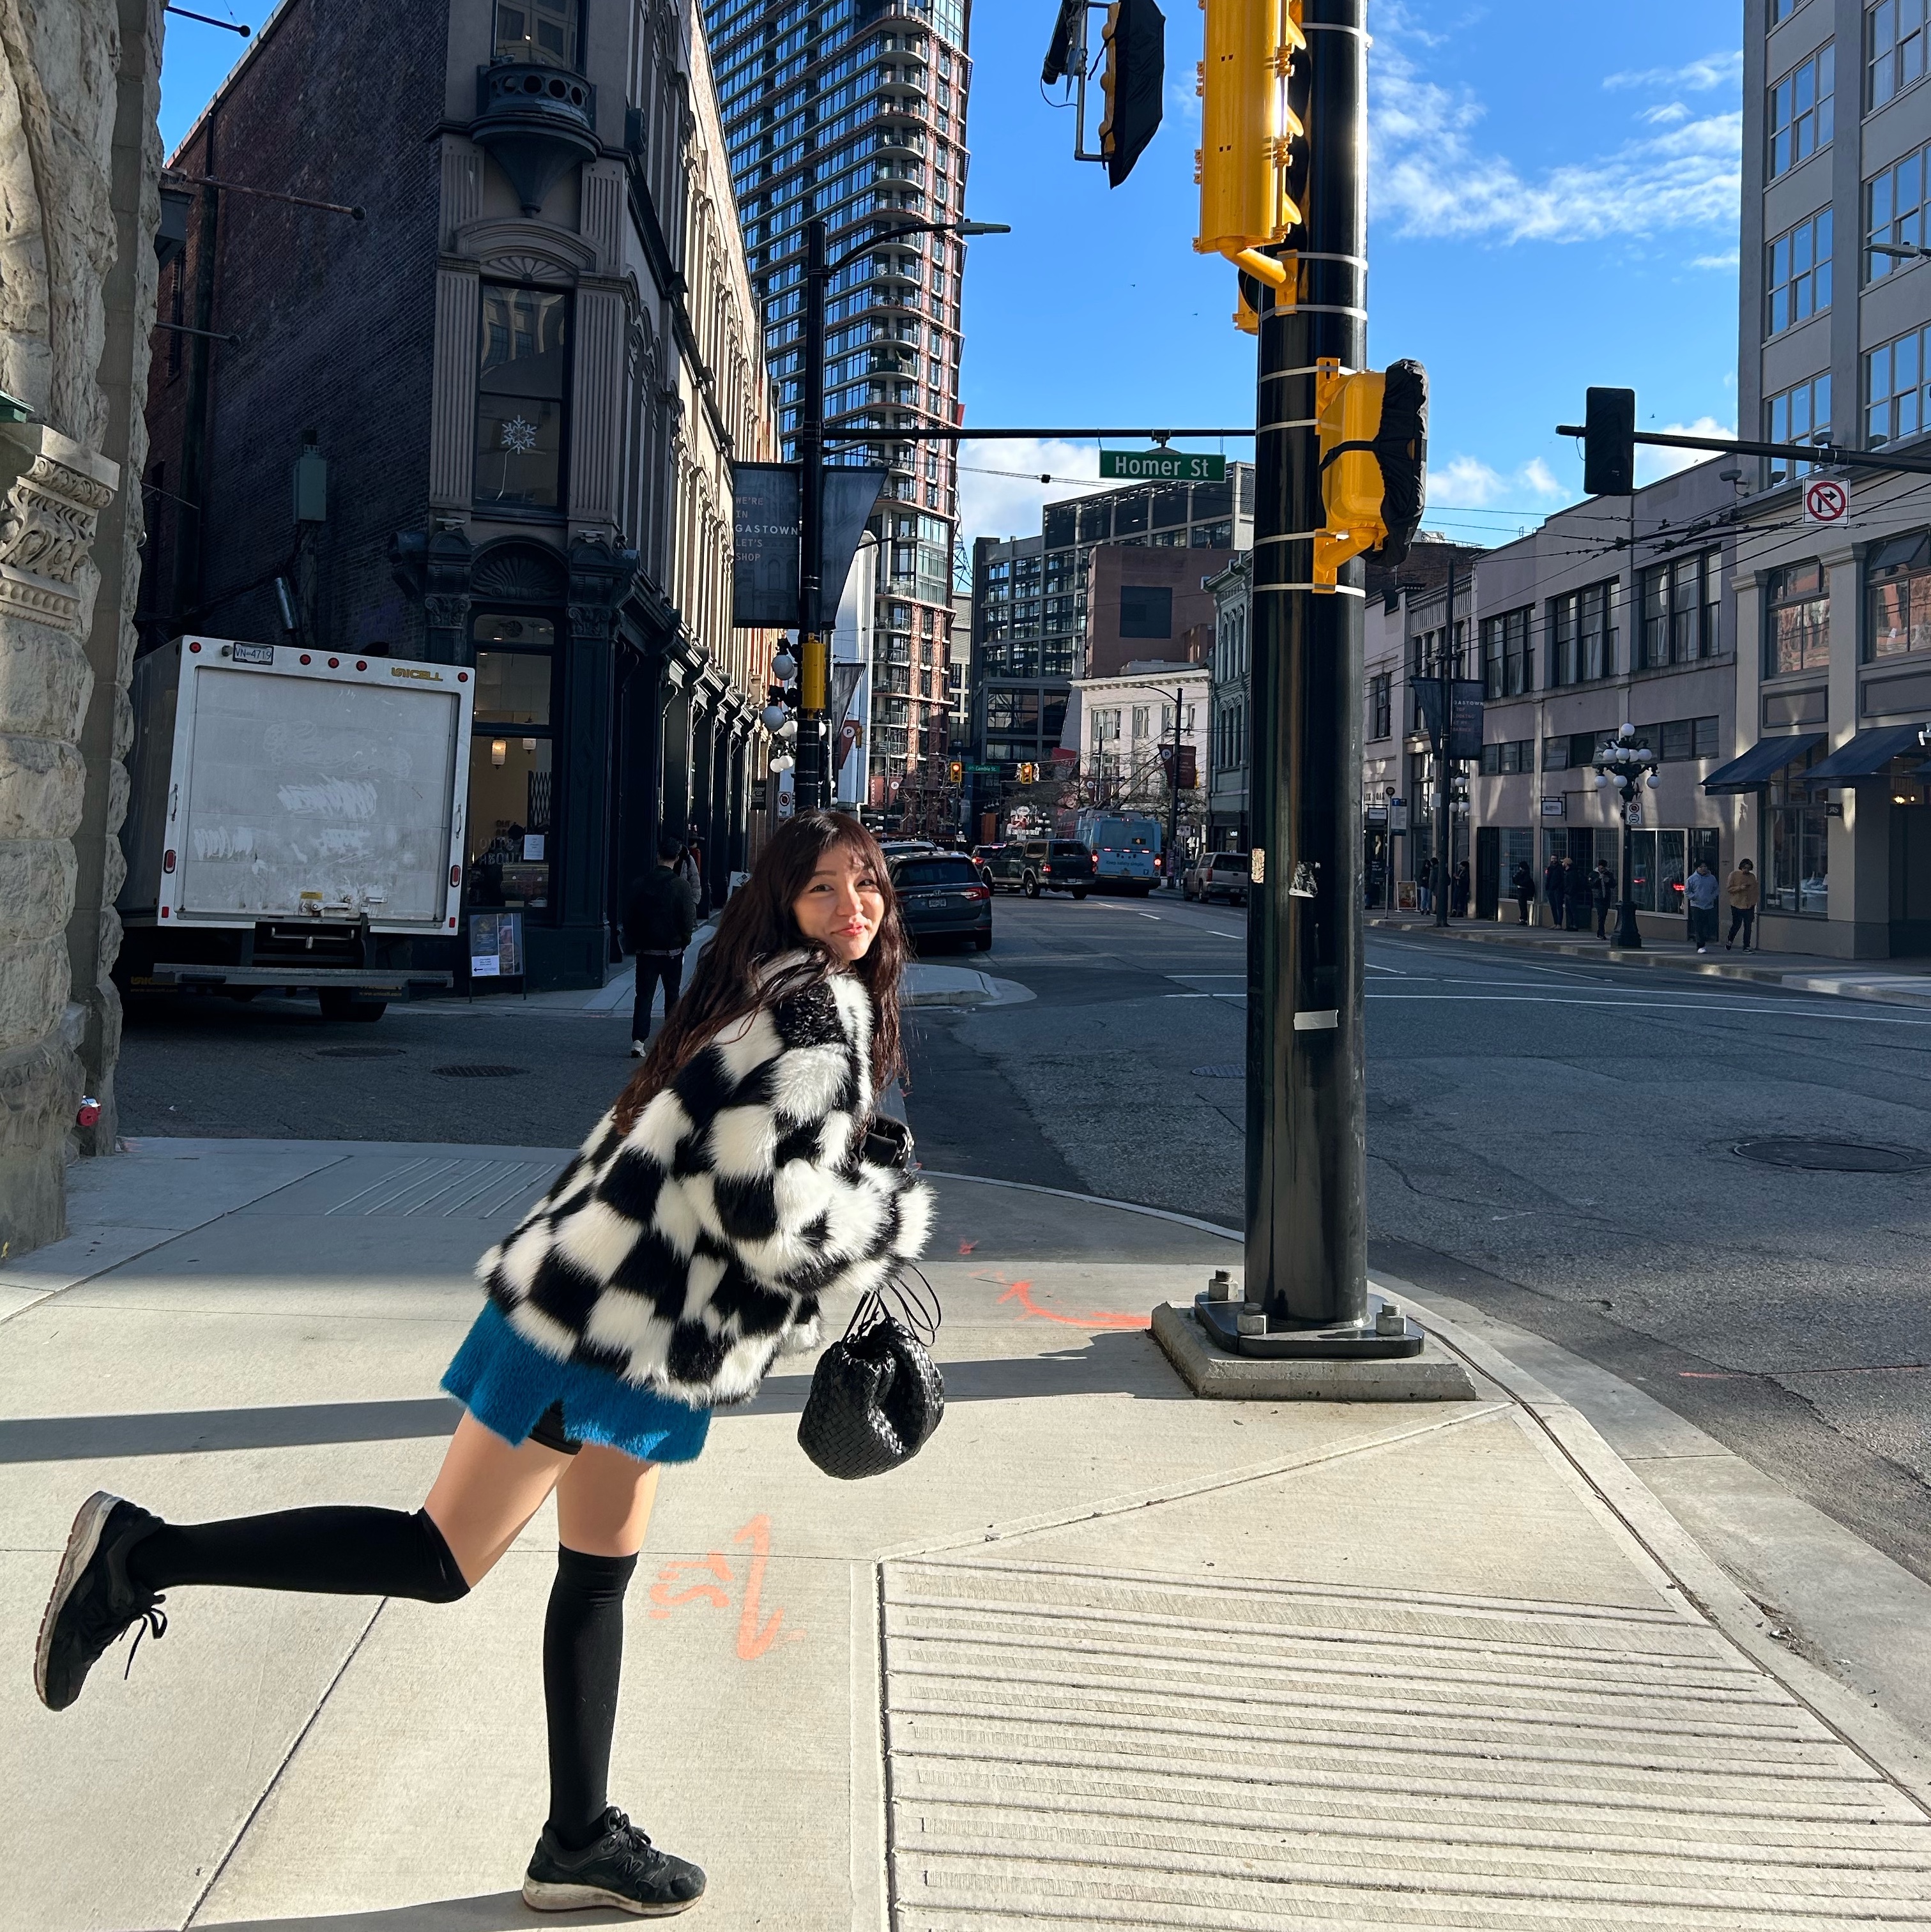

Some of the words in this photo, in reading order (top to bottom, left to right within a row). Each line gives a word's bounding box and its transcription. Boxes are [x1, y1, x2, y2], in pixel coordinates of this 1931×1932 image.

[1115, 456, 1181, 476] Homer
[1191, 459, 1209, 476] St
[735, 496, 763, 505] WE'RE
[735, 524, 798, 535] GASTOWN
[736, 538, 763, 547] LET'S
[736, 552, 761, 561] SHOP
[478, 852, 522, 865] ABOUT
